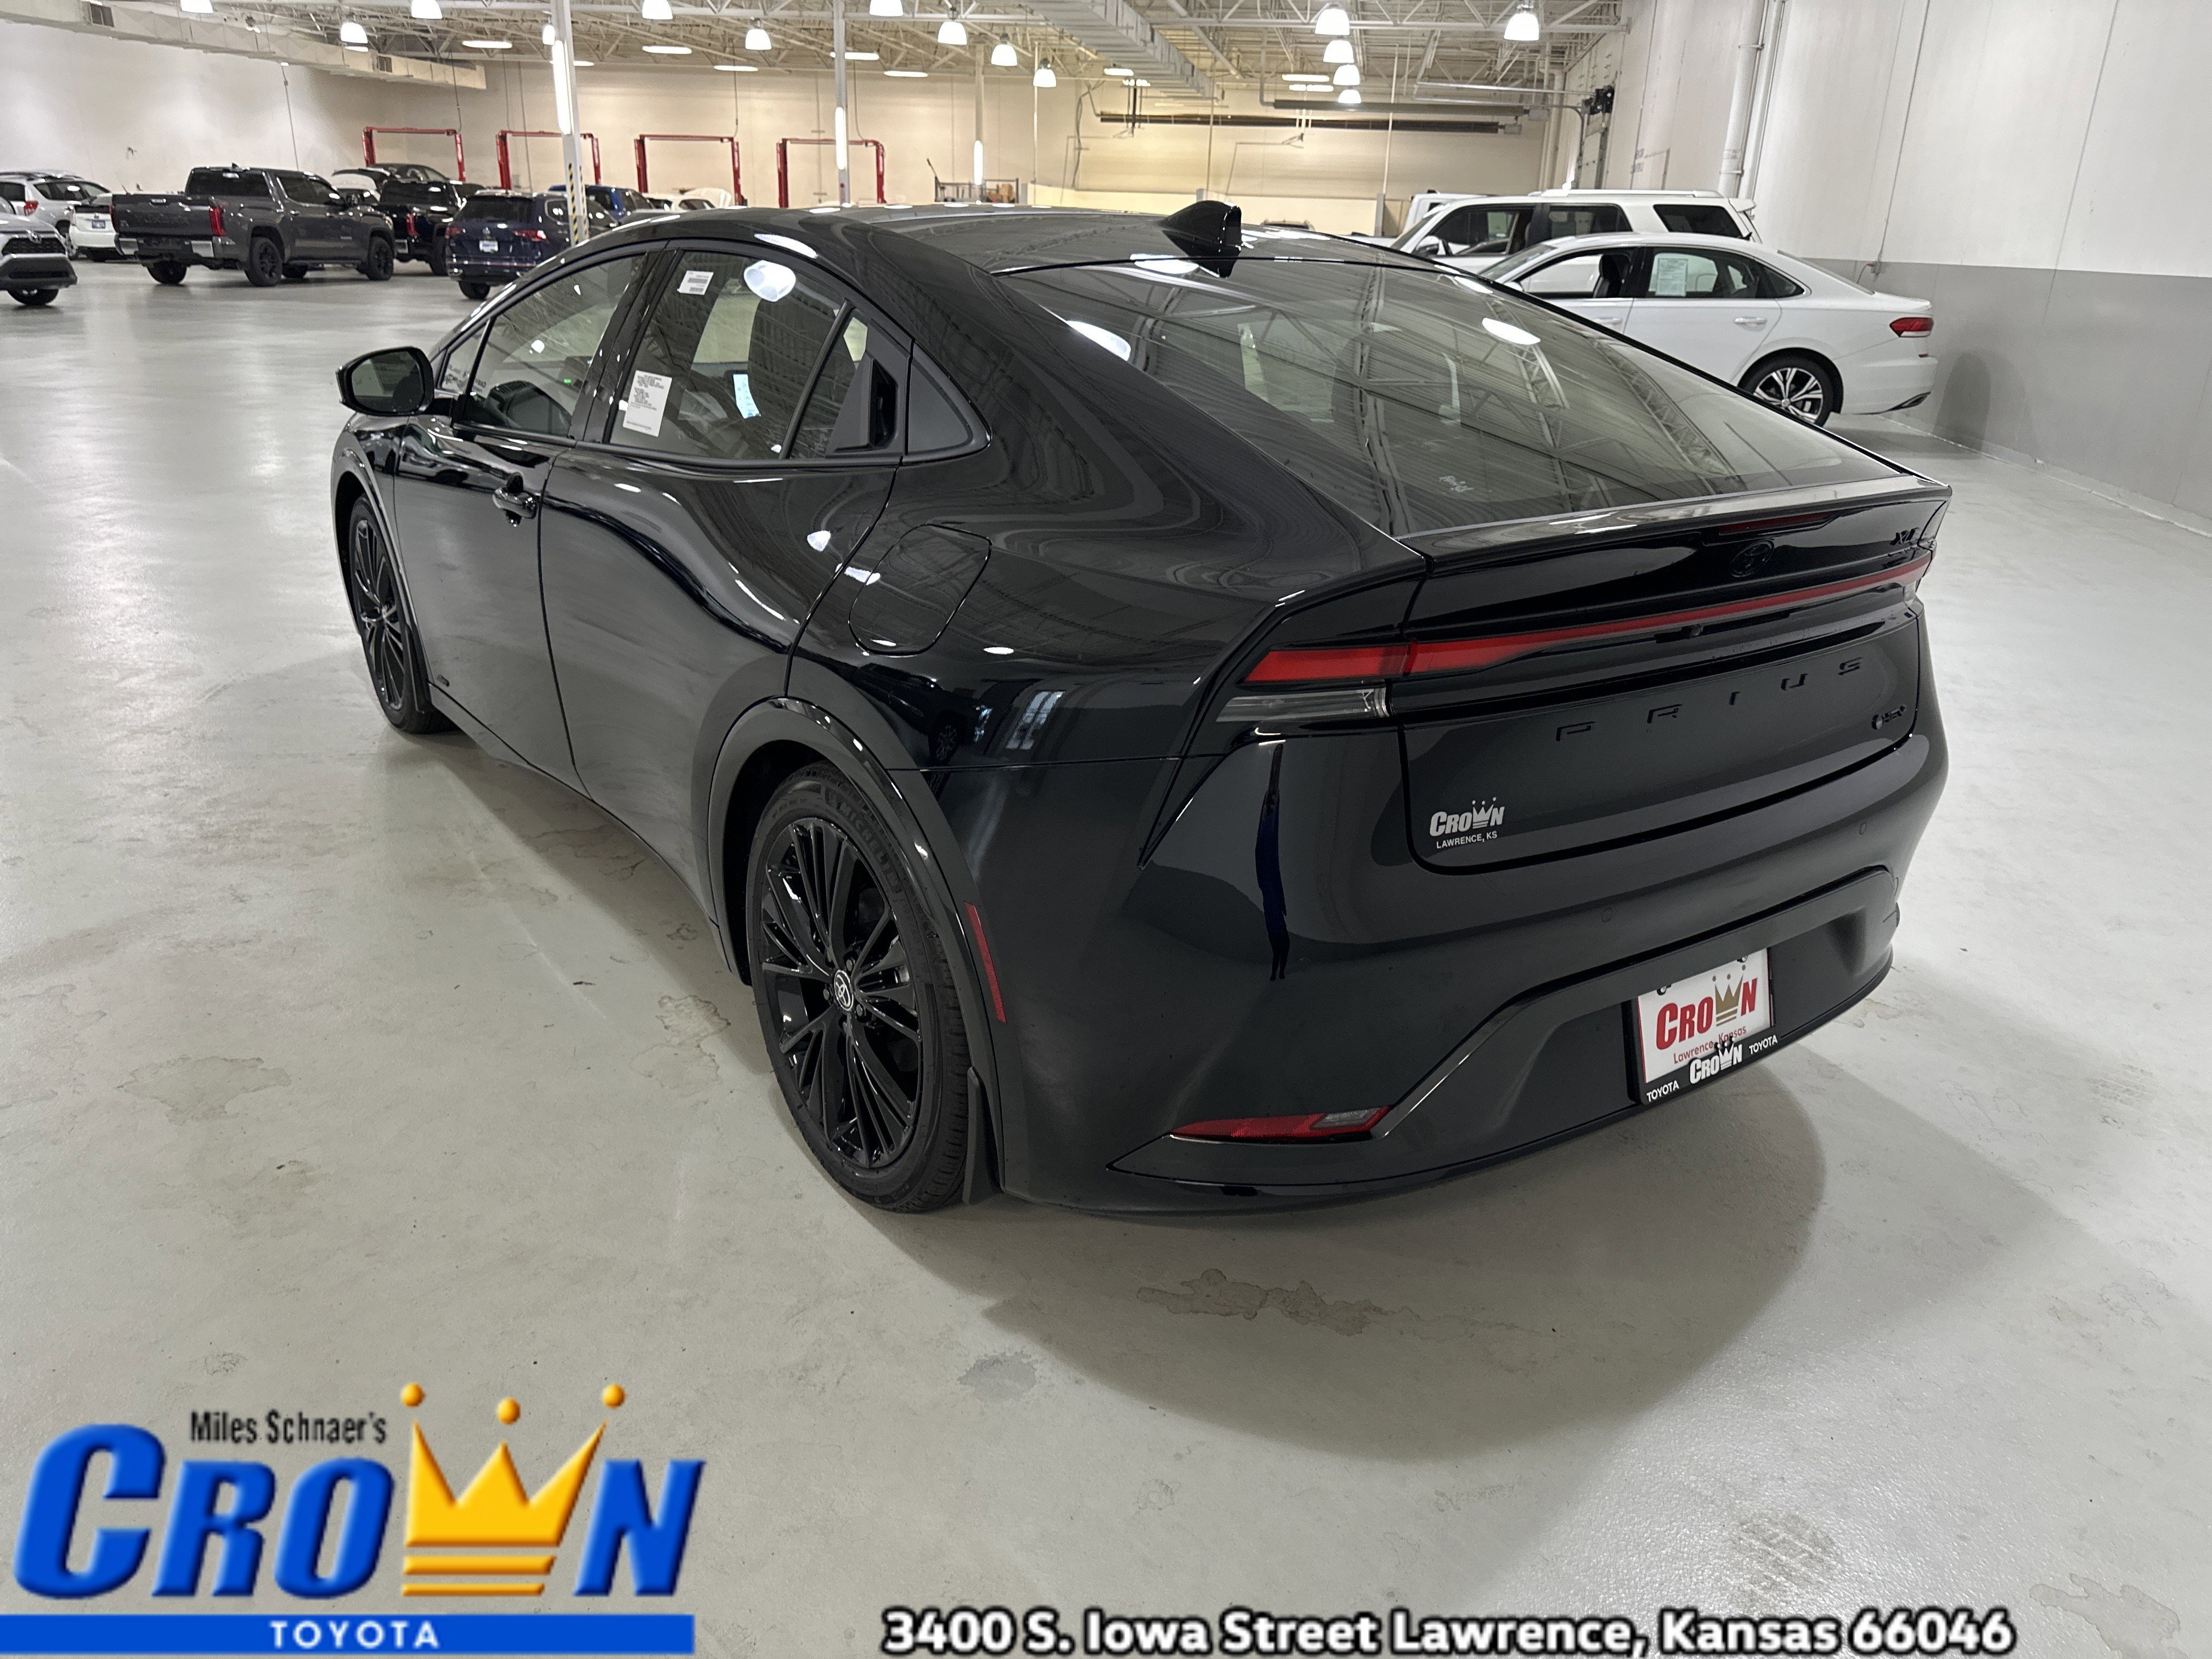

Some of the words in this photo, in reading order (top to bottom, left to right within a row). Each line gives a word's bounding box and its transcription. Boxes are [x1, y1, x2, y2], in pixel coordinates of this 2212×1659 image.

[1555, 657, 1863, 742] PRIUS
[1430, 798, 1505, 837] CROWN
[1436, 833, 1485, 849] LAWRENCE,
[1486, 830, 1498, 840] KS
[1656, 966, 1758, 1050] CROWN
[1718, 1026, 1747, 1044] Kansas
[1646, 1080, 1680, 1102] TOYOTA
[1689, 1039, 1743, 1084] CROWN
[1748, 1035, 1778, 1054] TOYOTA
